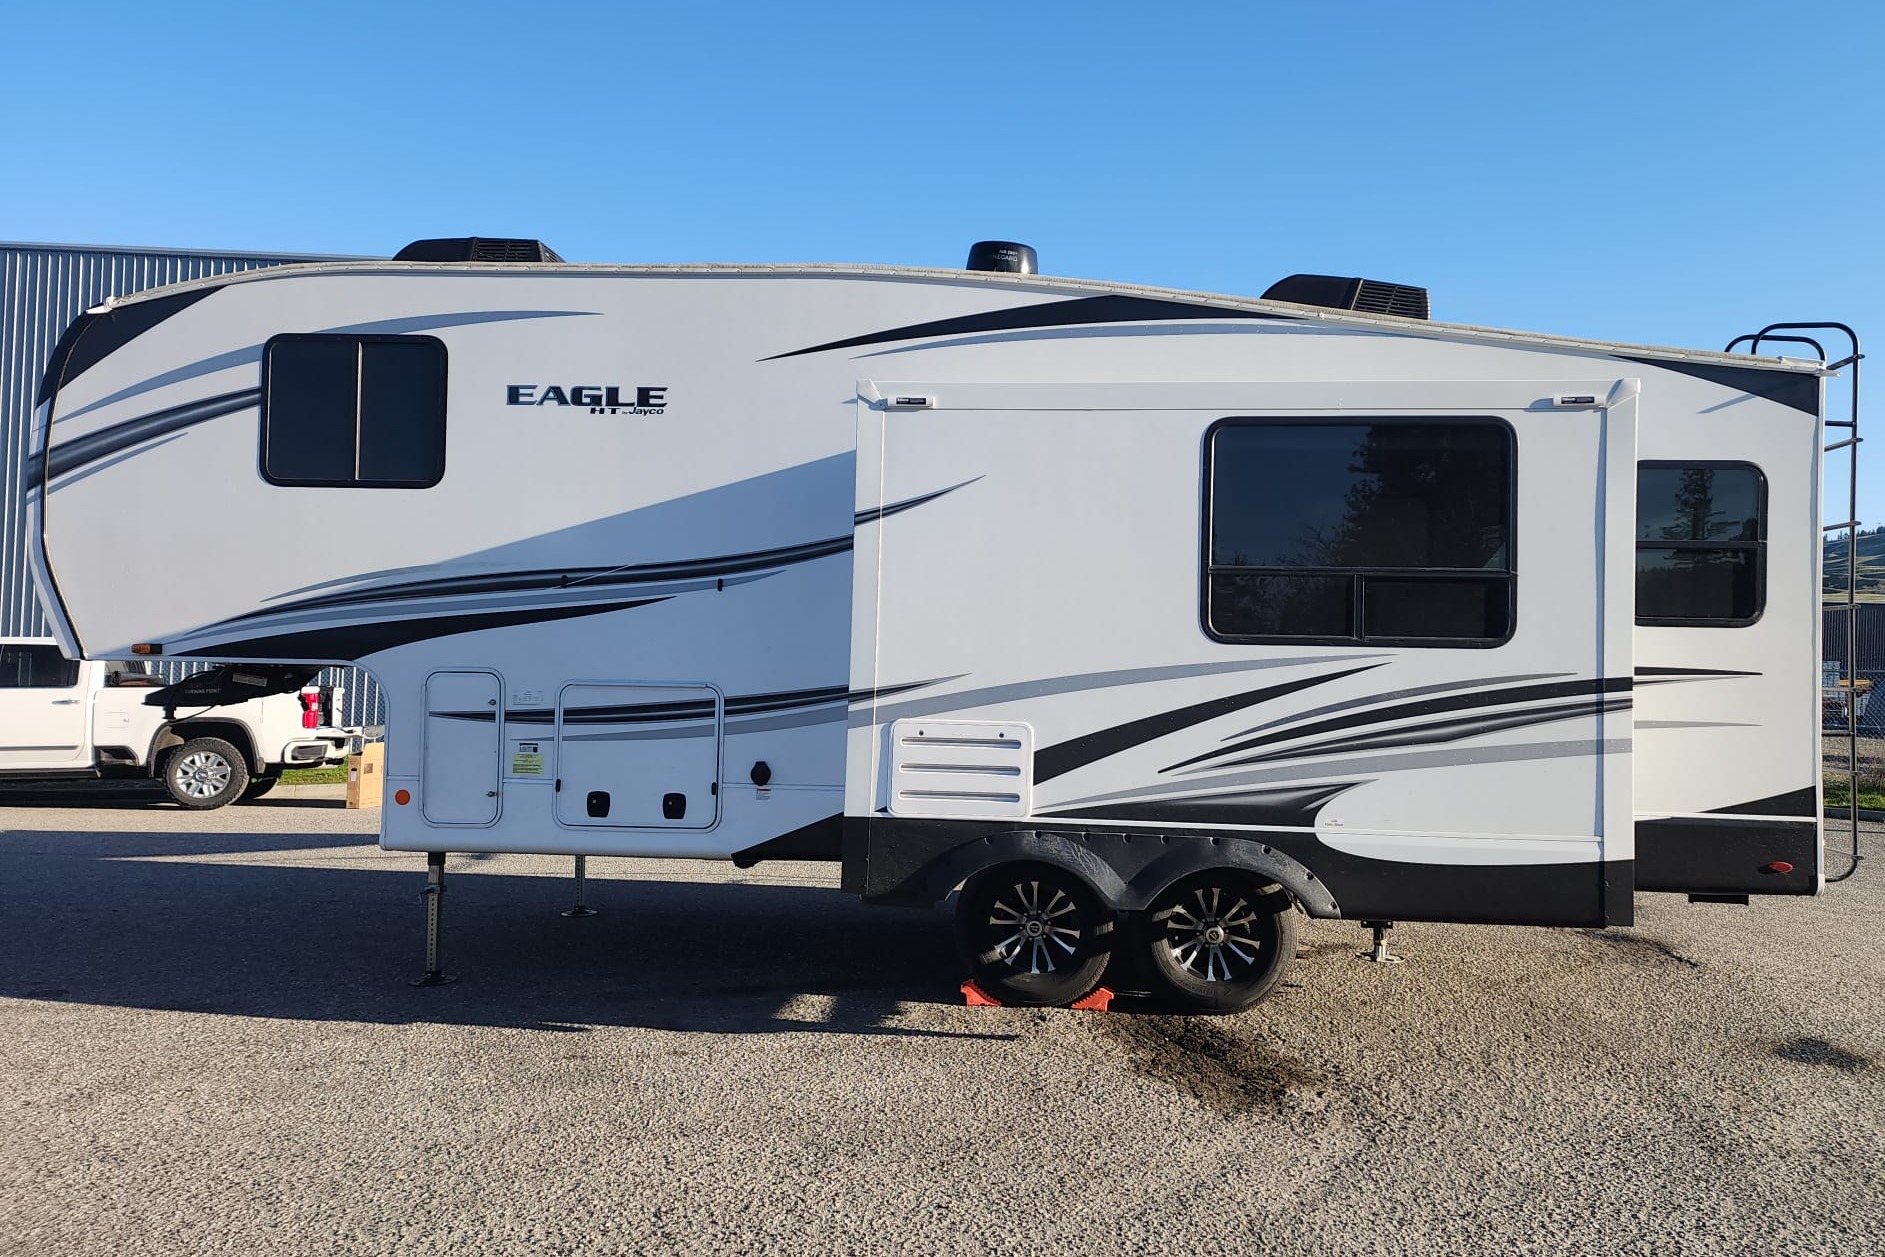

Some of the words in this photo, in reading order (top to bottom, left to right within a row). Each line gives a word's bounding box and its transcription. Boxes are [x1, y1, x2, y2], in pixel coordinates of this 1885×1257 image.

[506, 384, 668, 408] EAGLE
[589, 407, 621, 415] HT
[628, 406, 665, 417] Jayco
